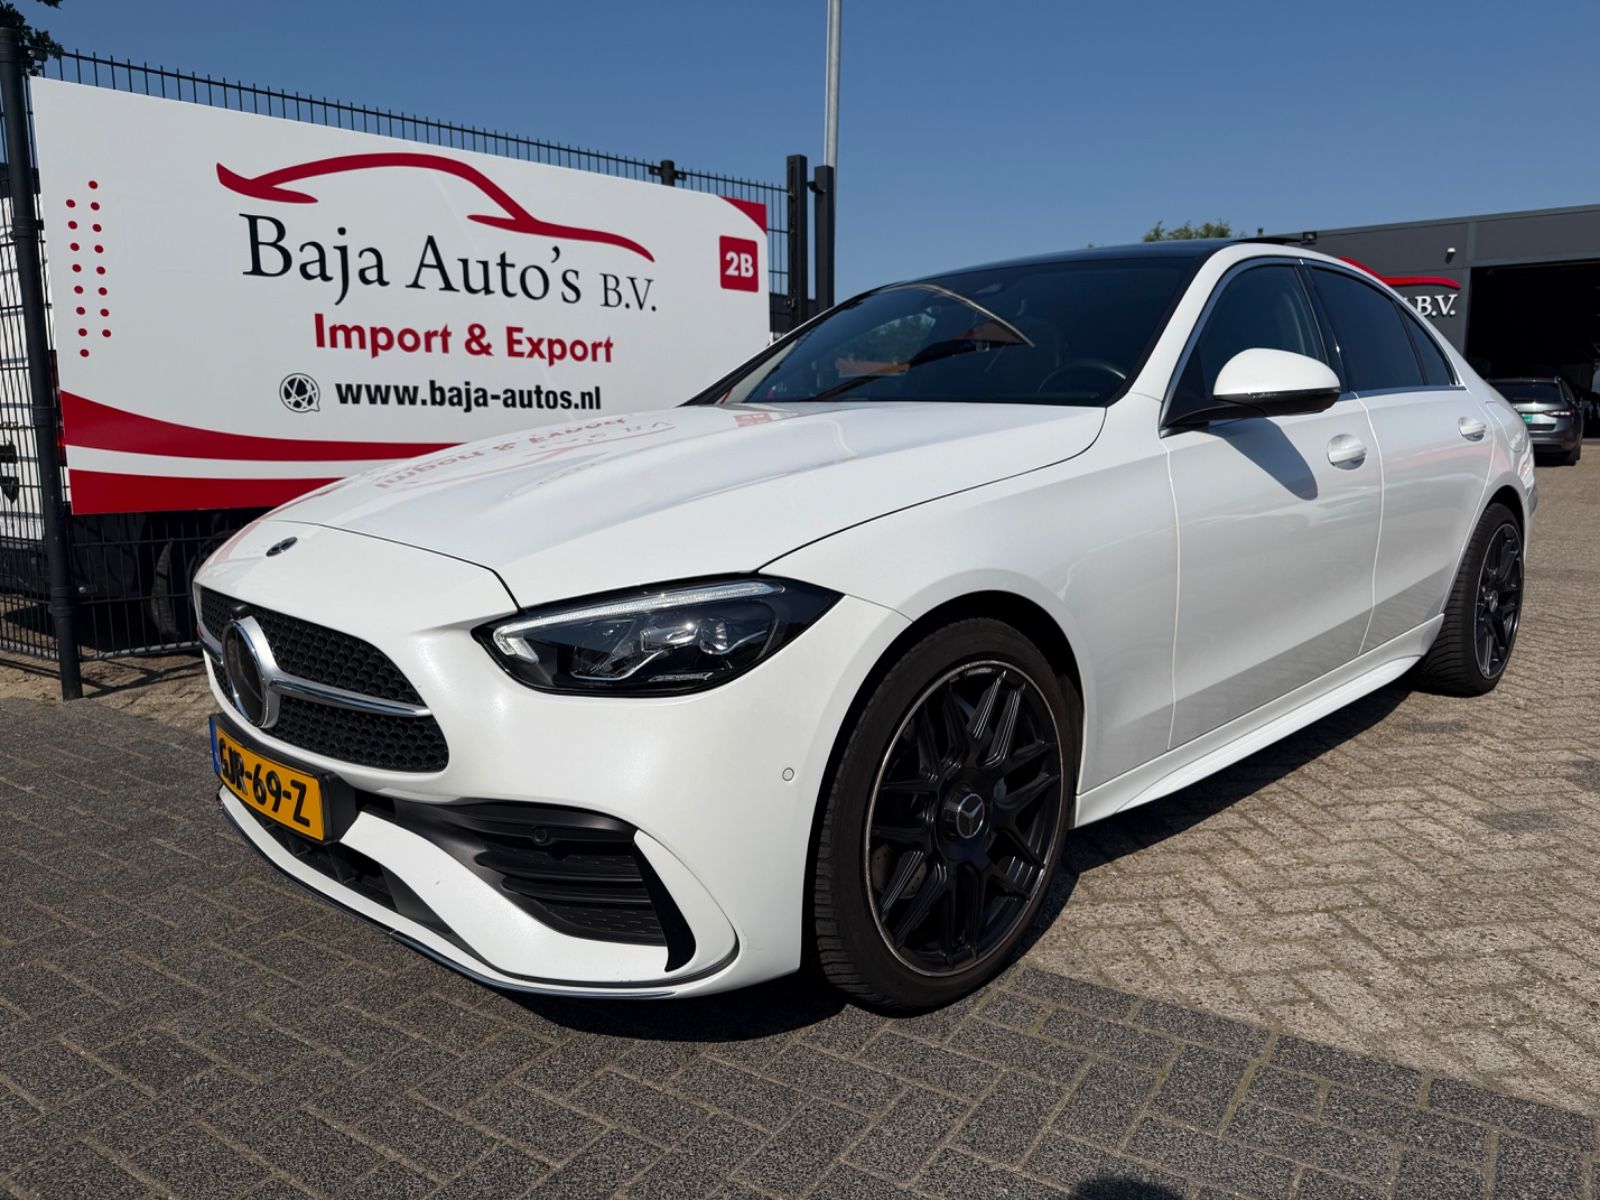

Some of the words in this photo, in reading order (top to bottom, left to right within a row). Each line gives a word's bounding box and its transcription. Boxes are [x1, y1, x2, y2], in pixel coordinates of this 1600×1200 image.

[239, 213, 391, 305] Baja
[405, 235, 582, 304] Auto's
[599, 273, 657, 312] B.V.
[725, 251, 755, 278] 2B
[1415, 294, 1458, 316] B.V.
[314, 313, 452, 358] Import
[464, 322, 492, 356] &
[505, 325, 613, 367] Export
[335, 379, 602, 414] www.baja-autos.nl
